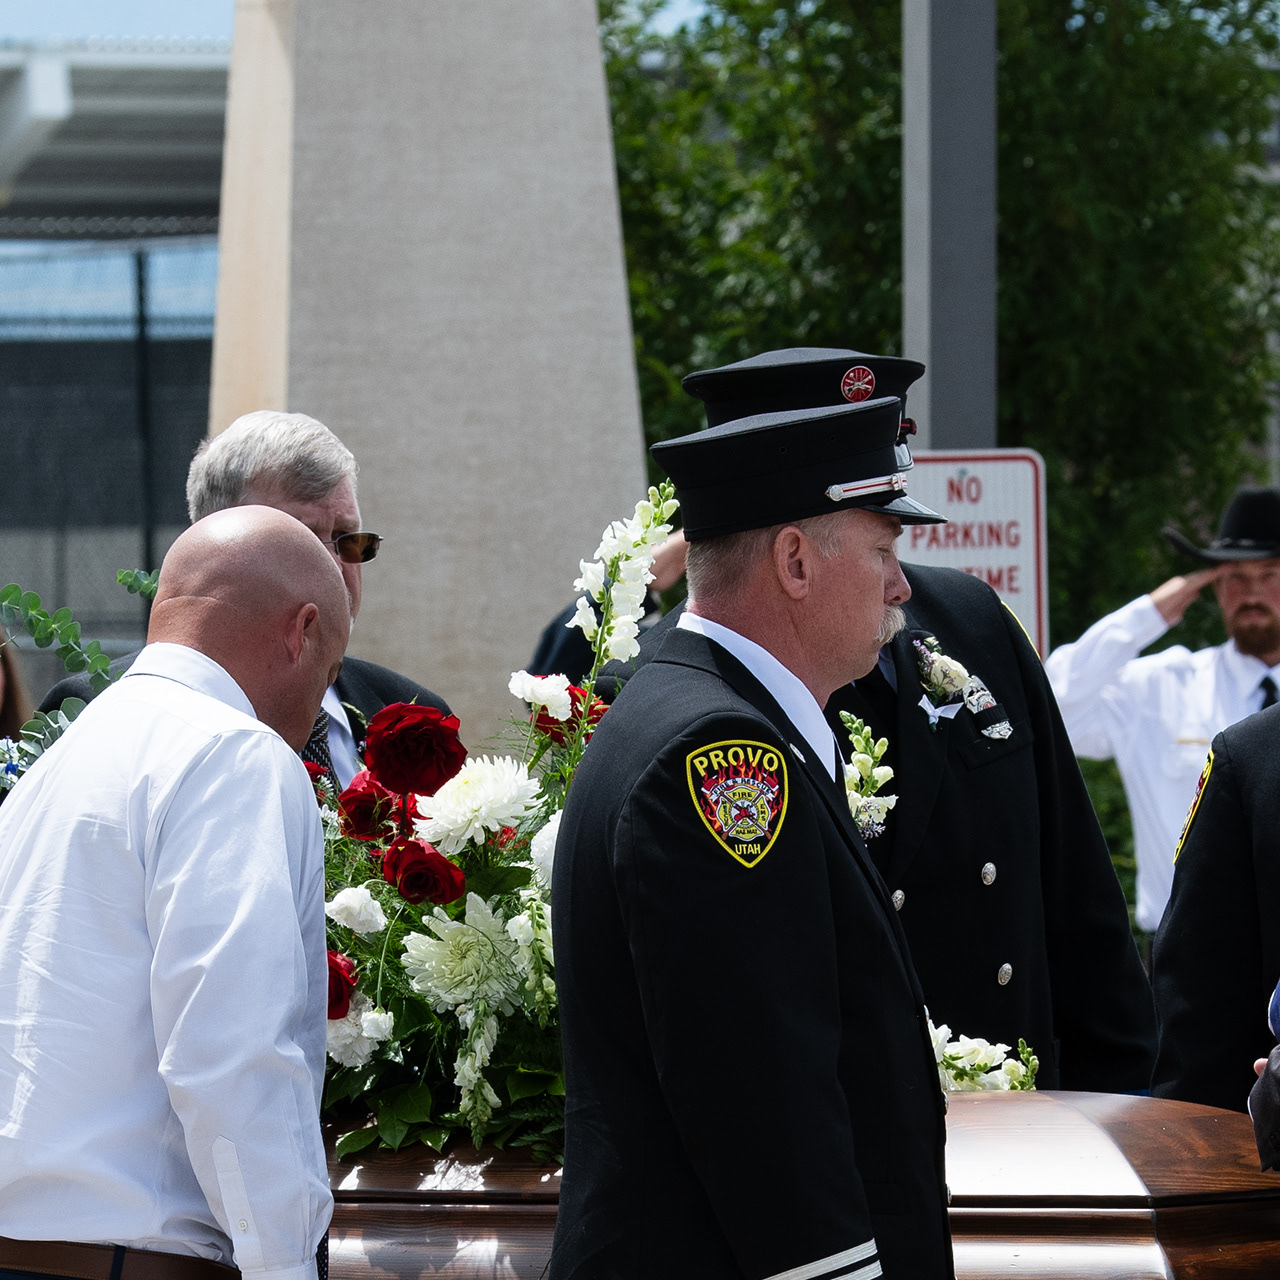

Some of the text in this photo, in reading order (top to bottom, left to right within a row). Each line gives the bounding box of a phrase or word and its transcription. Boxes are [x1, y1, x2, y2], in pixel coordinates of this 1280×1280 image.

[947, 476, 982, 504] NO
[910, 520, 1021, 550] PARKING
[693, 747, 779, 776] PROVO
[735, 843, 761, 855] UTAH
